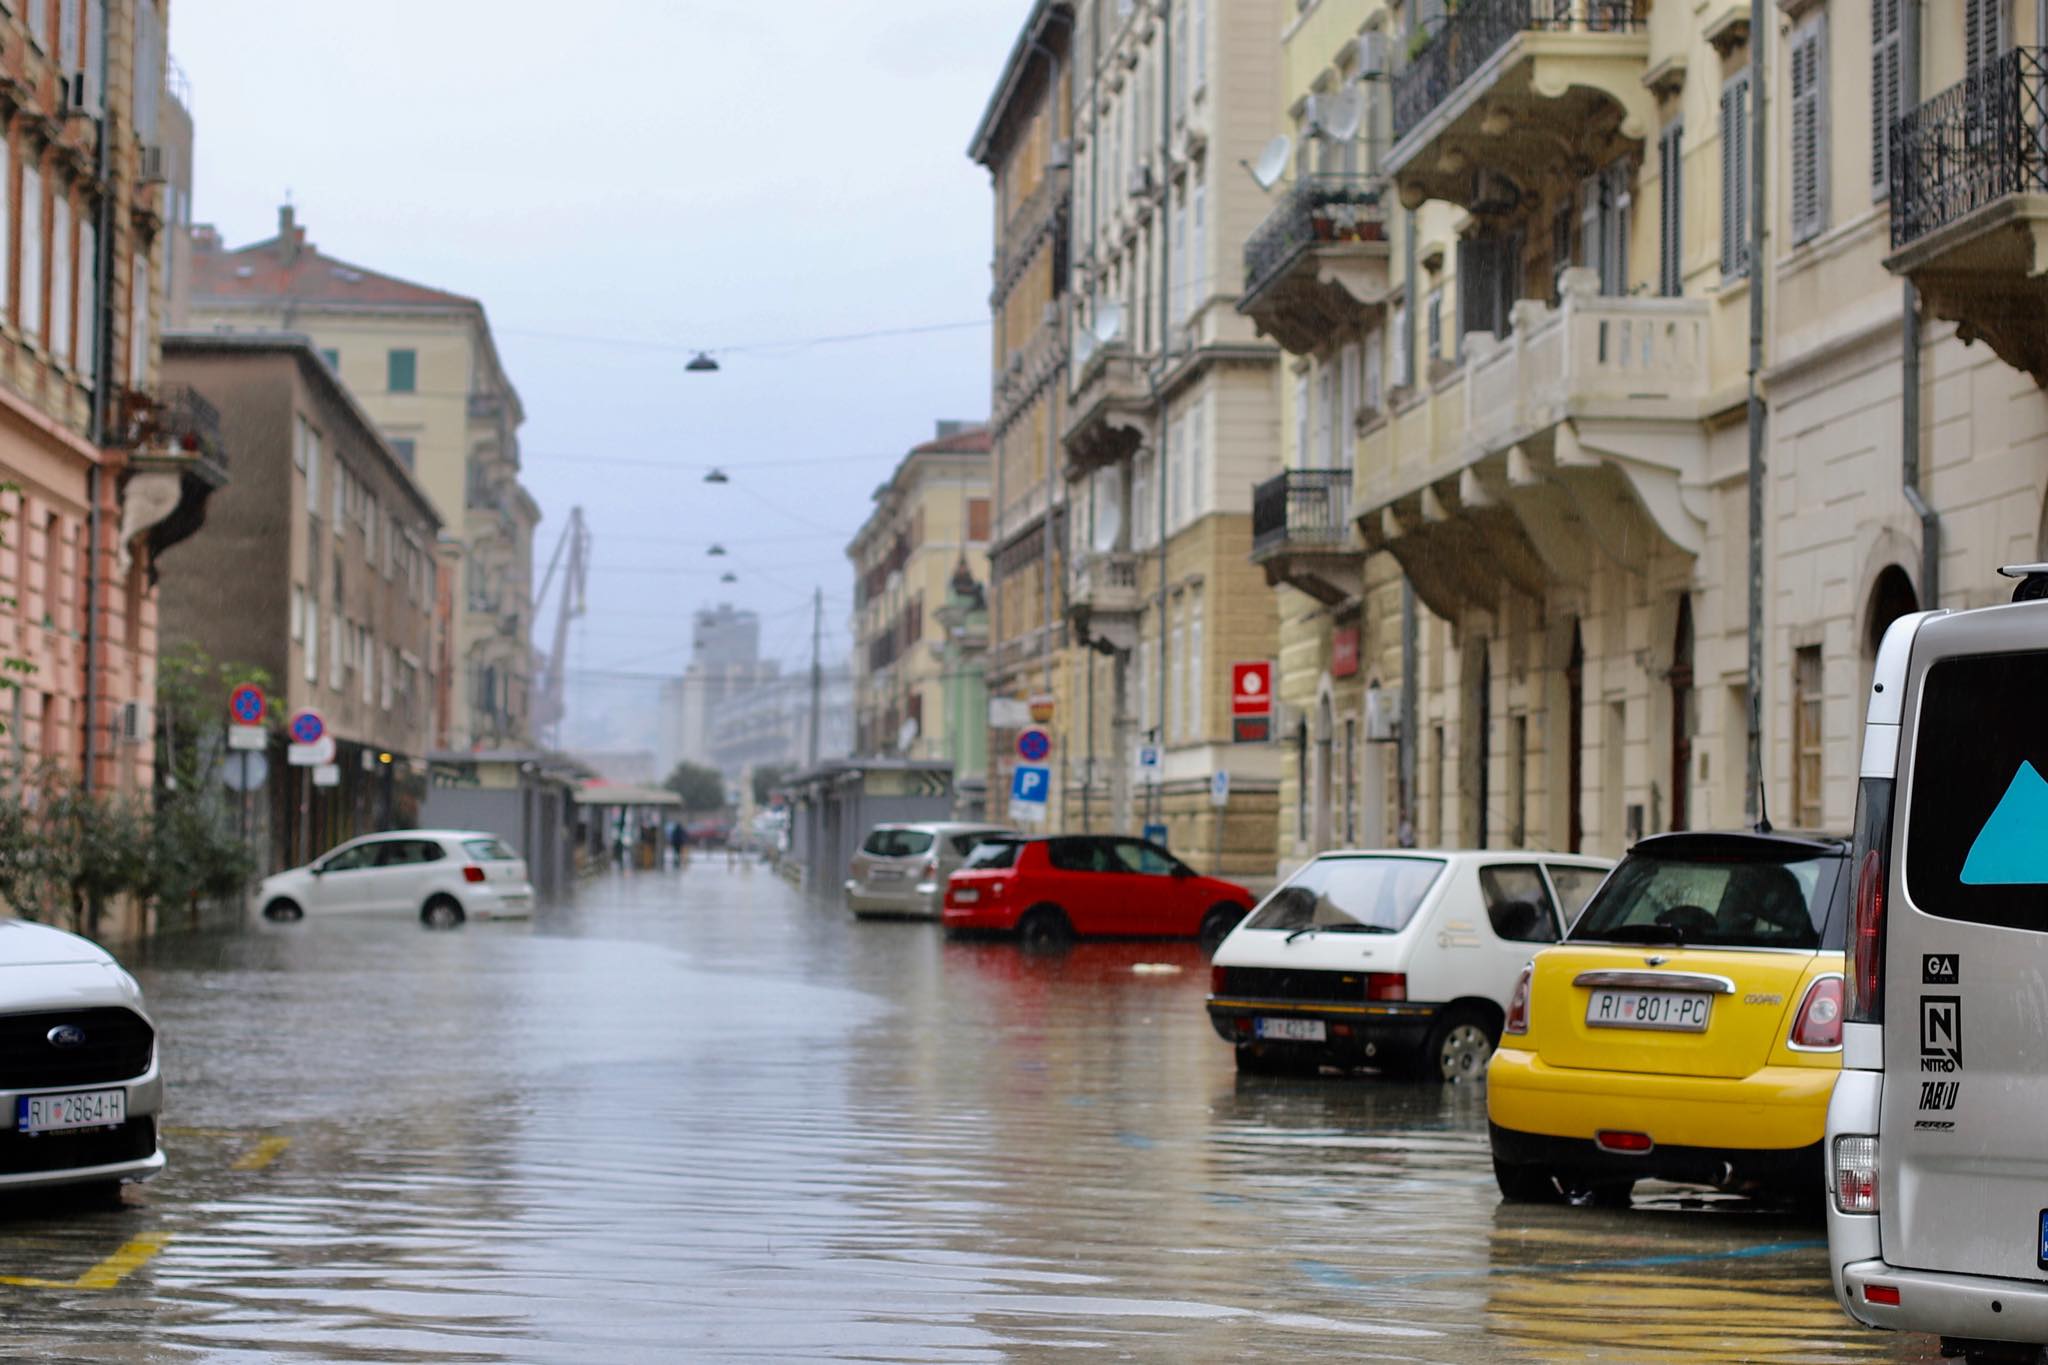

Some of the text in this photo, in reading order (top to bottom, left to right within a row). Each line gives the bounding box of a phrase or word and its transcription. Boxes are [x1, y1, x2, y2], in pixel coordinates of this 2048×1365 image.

[1021, 772, 1040, 795] P
[1600, 995, 1705, 1024] RI 801-PC
[1929, 1008, 1951, 1043] N
[1921, 1058, 1955, 1073] NITRO
[31, 1094, 119, 1125] RI 2864-H
